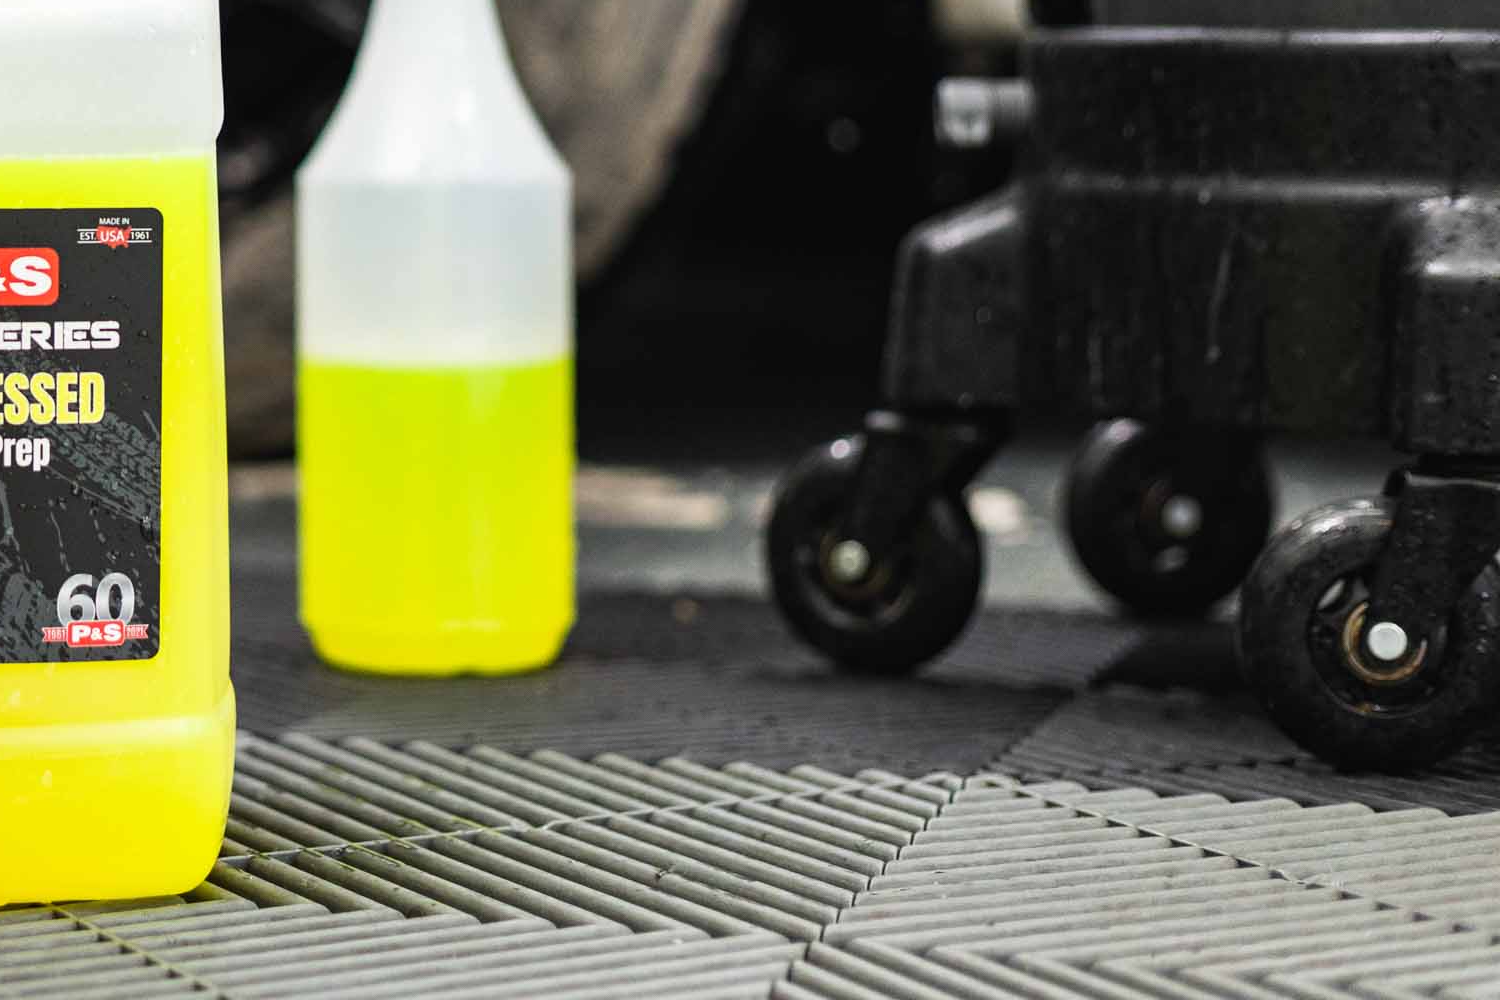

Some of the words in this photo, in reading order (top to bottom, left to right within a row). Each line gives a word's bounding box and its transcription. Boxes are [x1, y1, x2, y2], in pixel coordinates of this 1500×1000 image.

[99, 217, 120, 225] MADE
[80, 232, 96, 240] EST.
[100, 231, 125, 242] USA
[57, 573, 135, 627] 60
[72, 624, 120, 642] P&S
